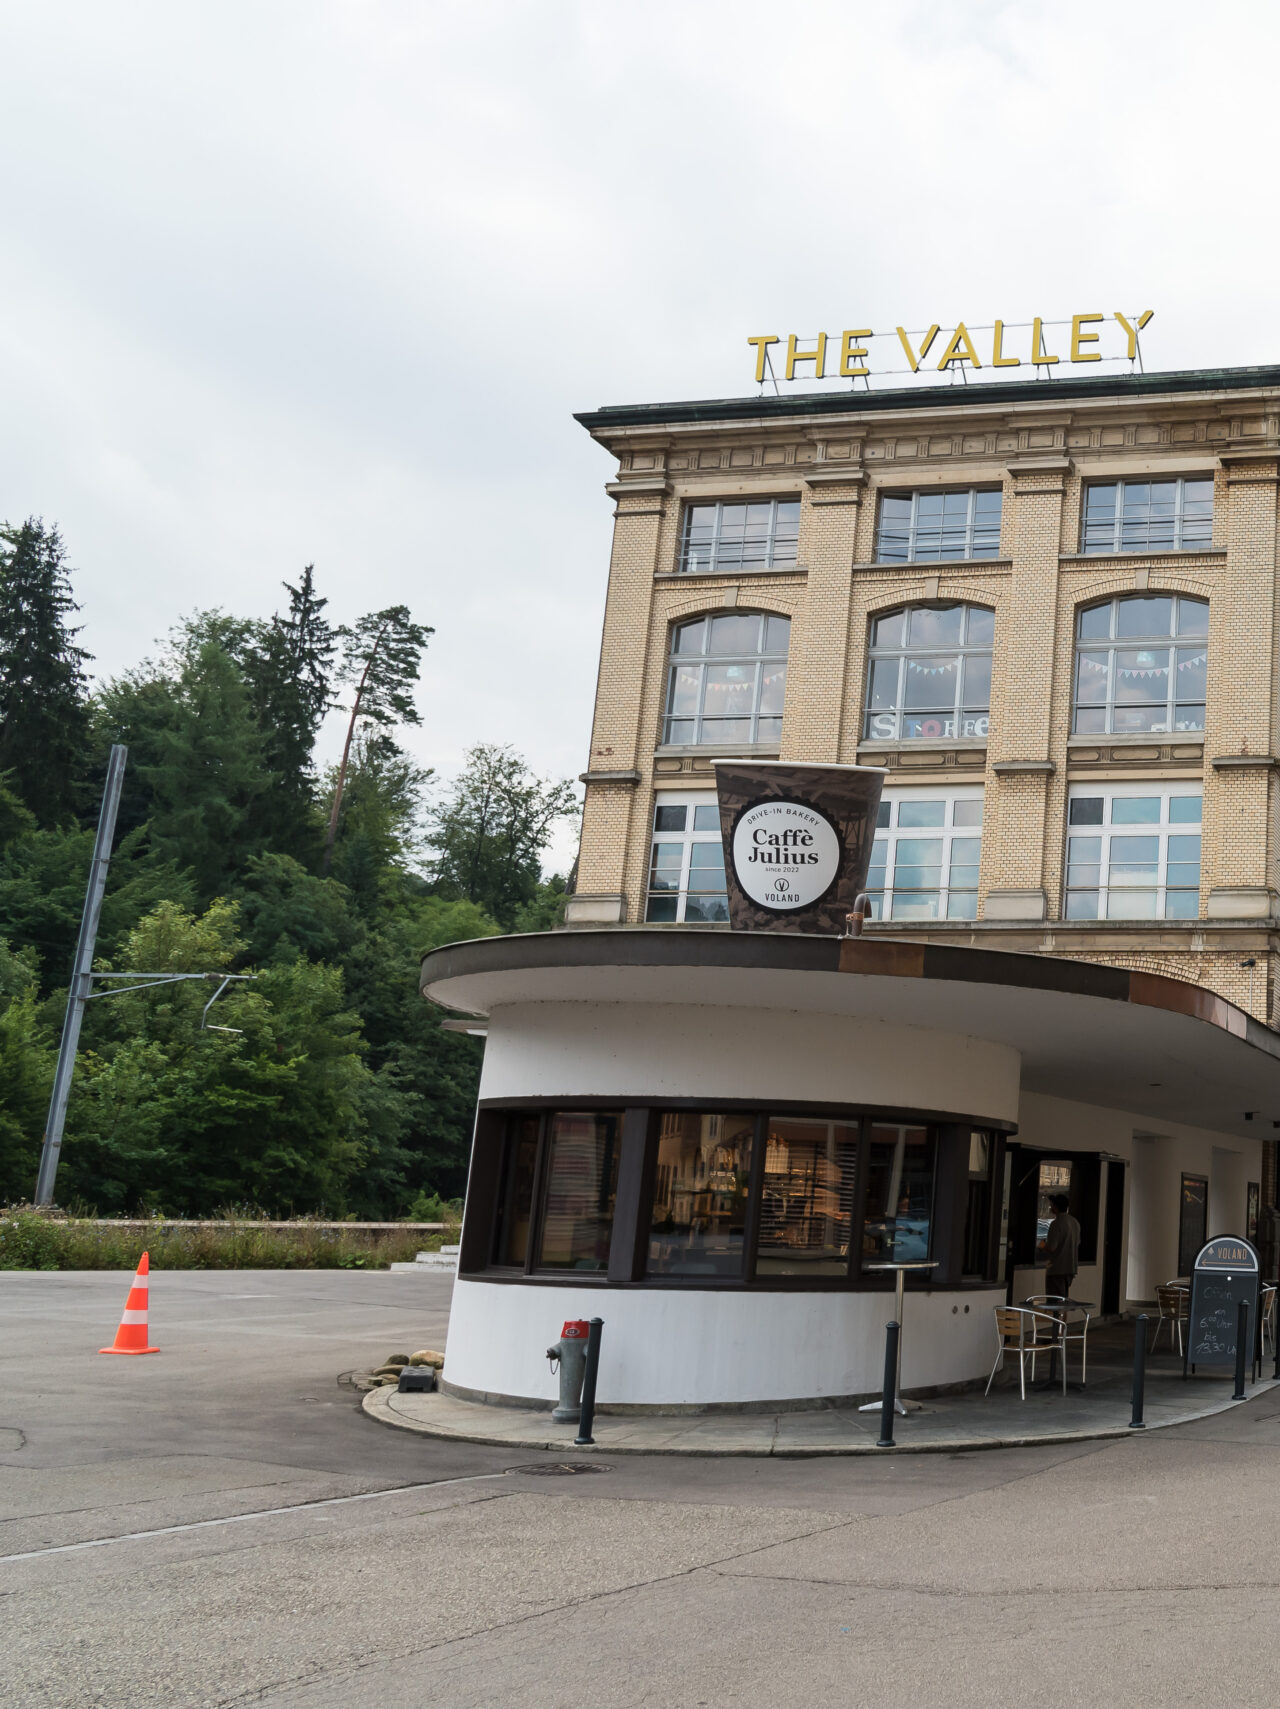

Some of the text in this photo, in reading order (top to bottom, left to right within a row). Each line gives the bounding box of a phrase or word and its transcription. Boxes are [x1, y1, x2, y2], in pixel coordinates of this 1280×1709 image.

[747, 310, 1155, 383] THE VALLEY
[746, 808, 821, 827] DRIVE-IN BAKERY
[752, 828, 814, 847] Caffè
[748, 847, 819, 865] Julius
[765, 893, 800, 903] VOLAND
[1217, 1247, 1248, 1260] VOLAND
